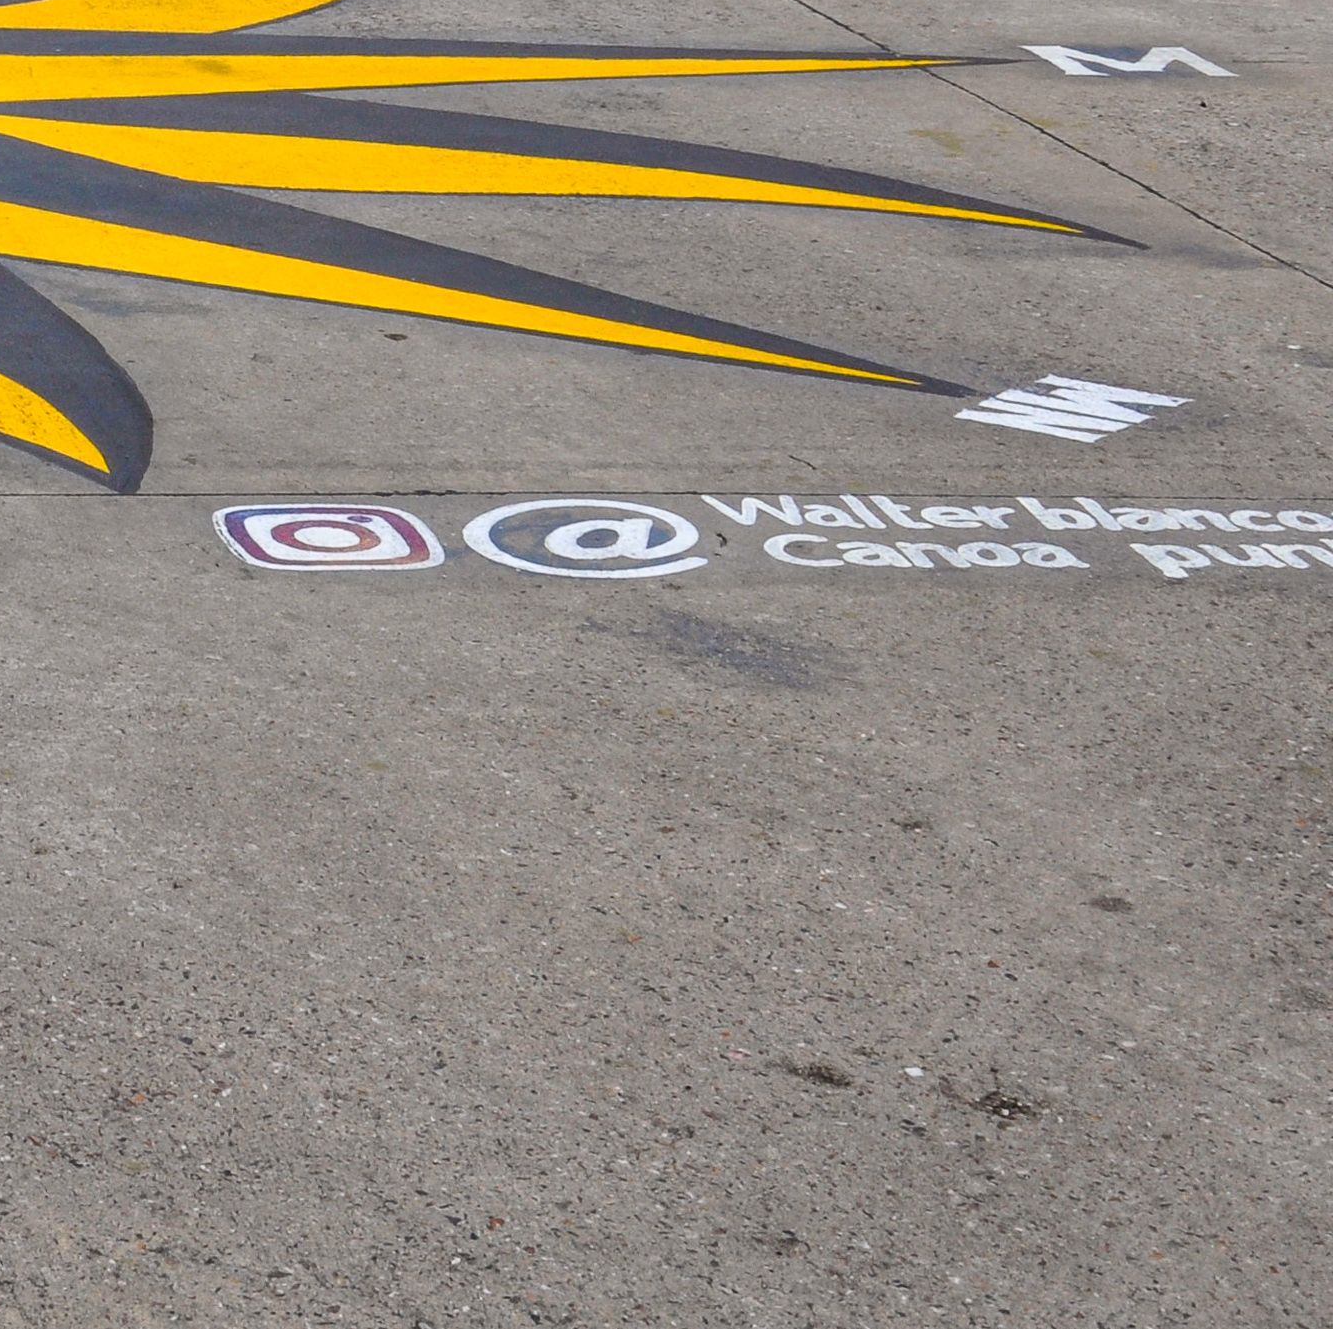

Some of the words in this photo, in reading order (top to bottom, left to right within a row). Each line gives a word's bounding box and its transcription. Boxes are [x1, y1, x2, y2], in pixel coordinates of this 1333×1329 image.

[700, 494, 1015, 529] Walter
[1015, 496, 1333, 533] blanco
[763, 533, 1091, 569] Canoa
[1129, 538, 1333, 579] pun
